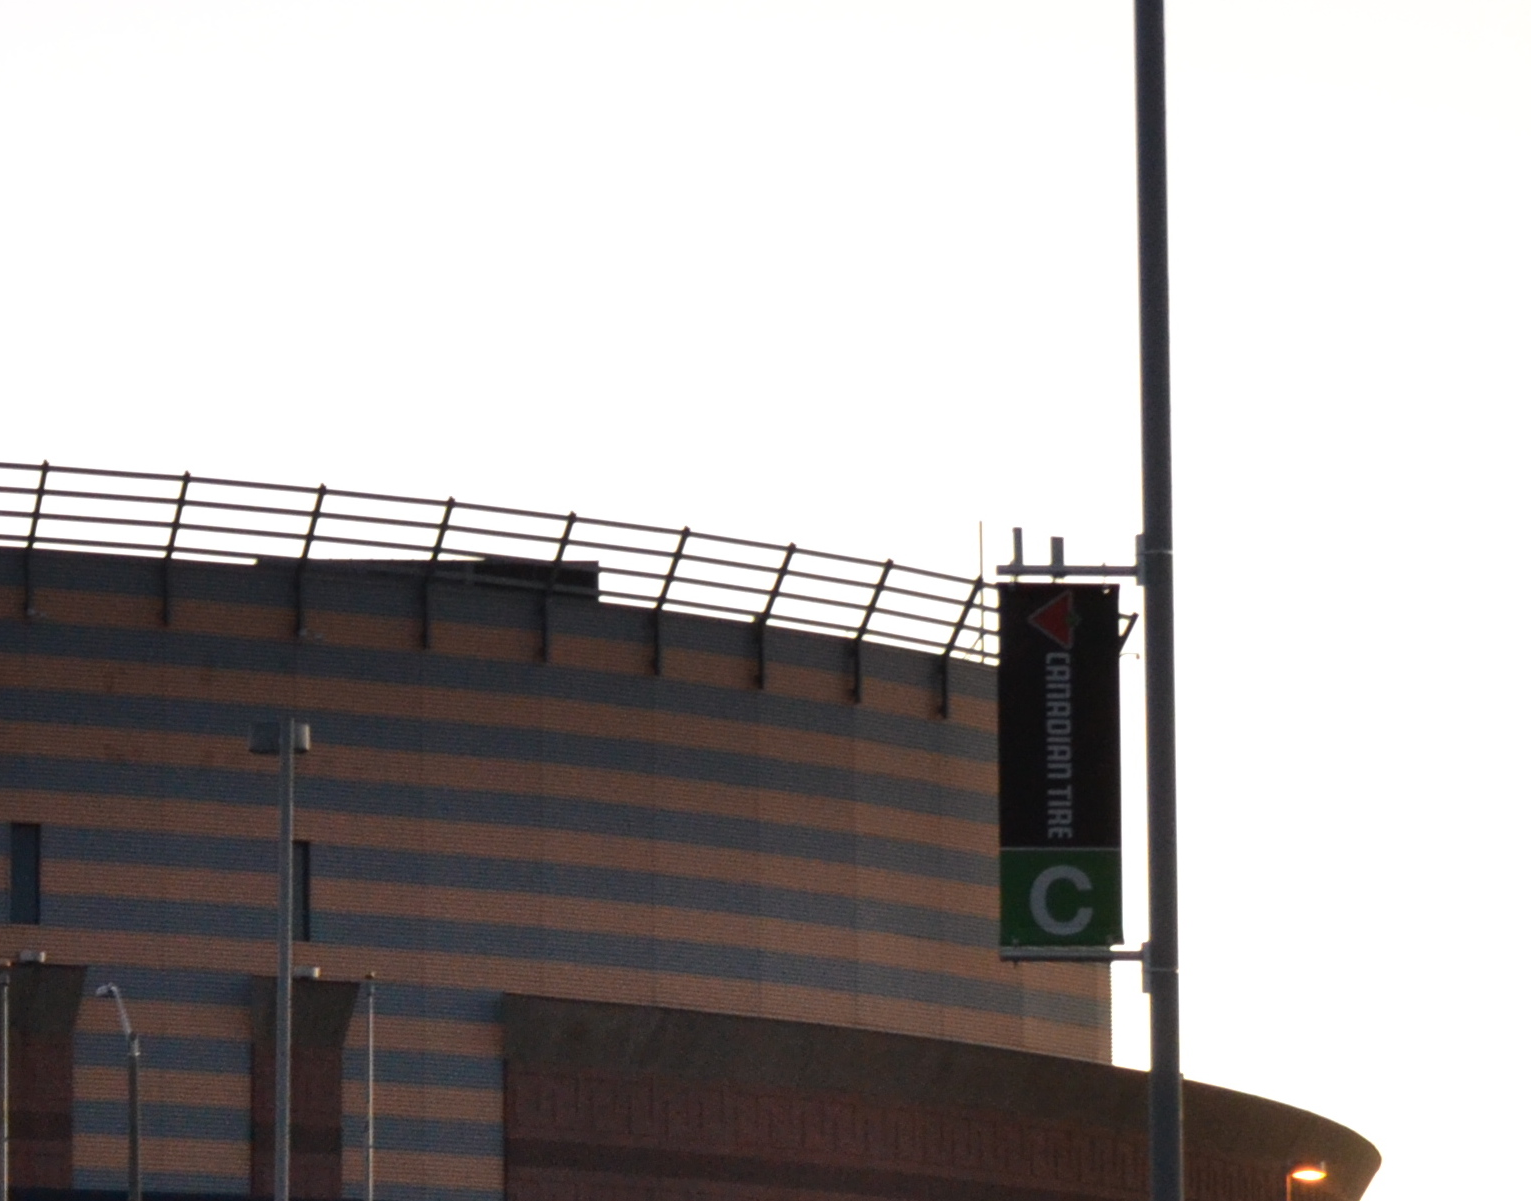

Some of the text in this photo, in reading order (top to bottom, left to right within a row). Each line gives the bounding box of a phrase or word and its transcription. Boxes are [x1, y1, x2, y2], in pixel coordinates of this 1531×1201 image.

[1045, 652, 1073, 839] CANADIAN TIRE
[1029, 864, 1093, 935] C
